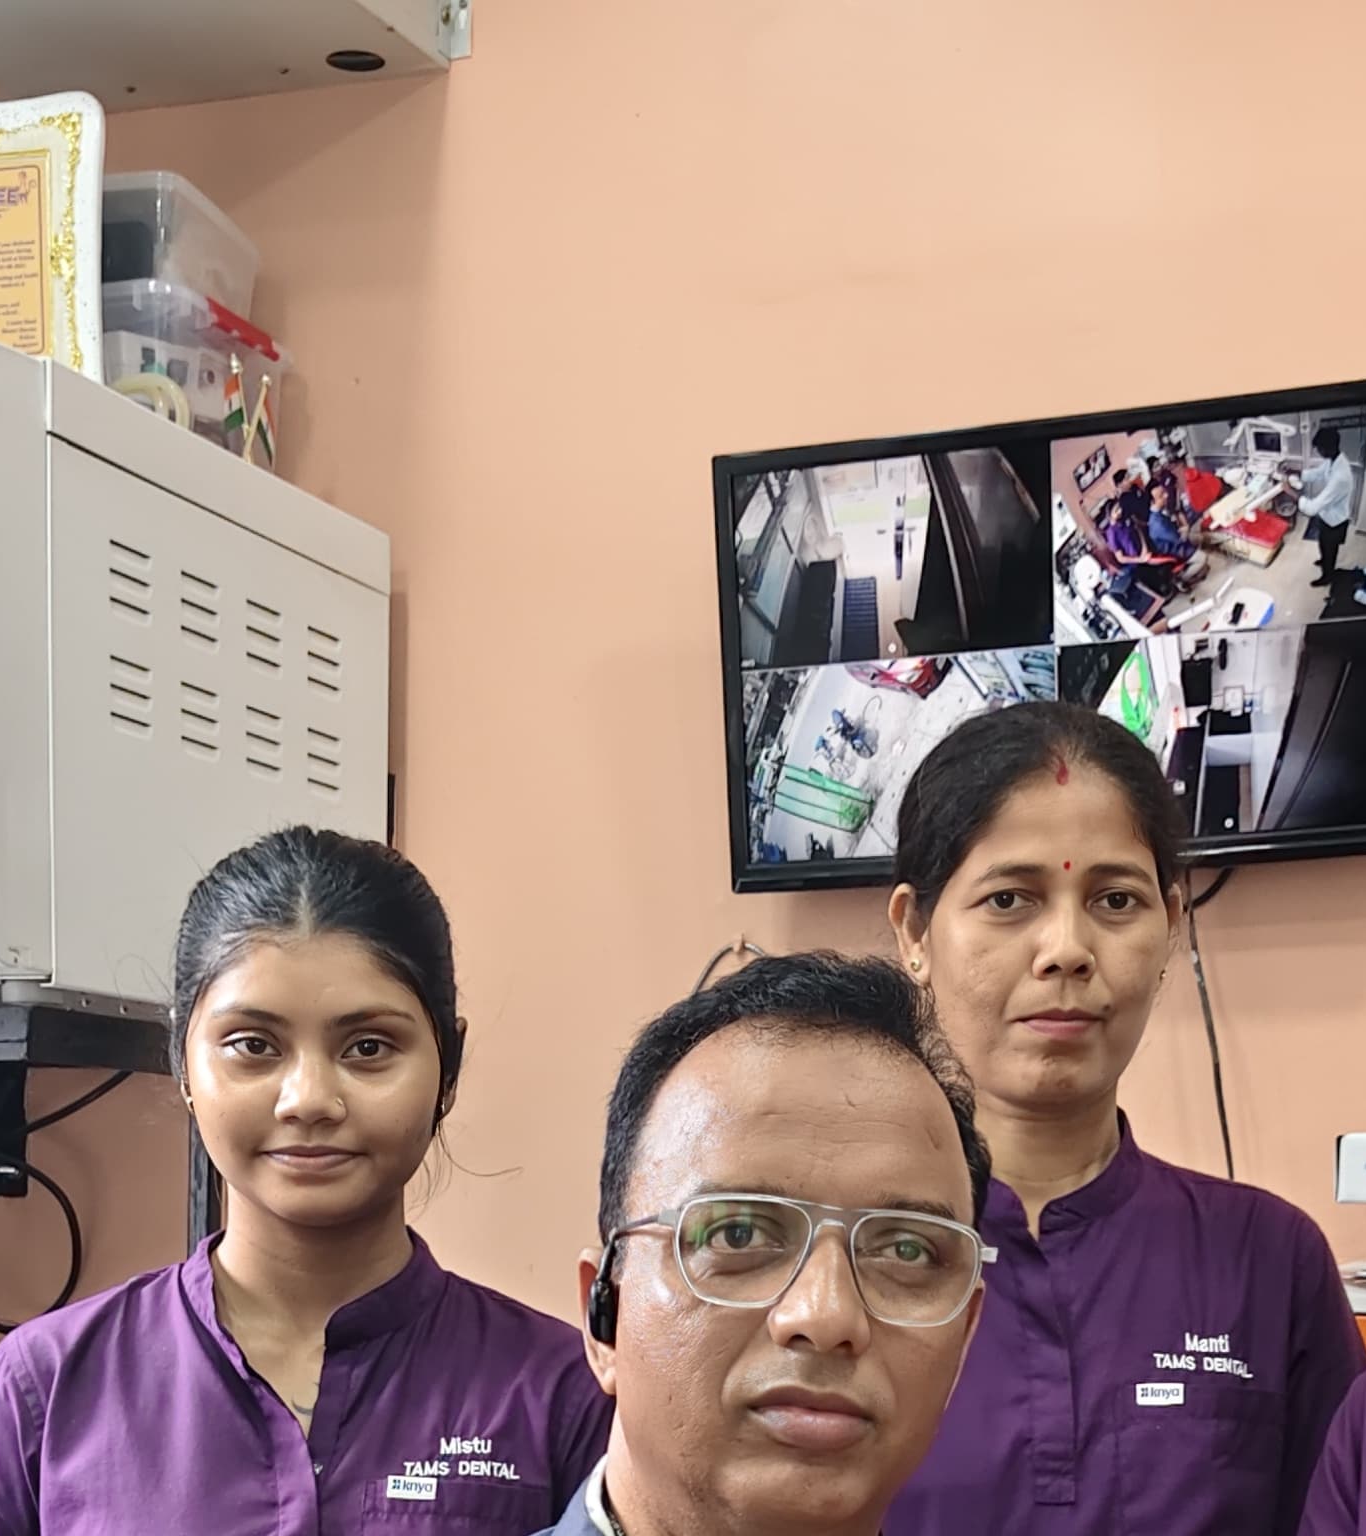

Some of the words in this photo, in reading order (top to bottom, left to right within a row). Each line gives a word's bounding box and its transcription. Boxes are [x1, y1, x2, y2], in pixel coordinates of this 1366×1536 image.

[1184, 1331, 1230, 1353] Manti
[1153, 1352, 1196, 1371] TAMS
[1202, 1356, 1254, 1379] DENTAL
[440, 1436, 493, 1455] Mistu
[403, 1460, 451, 1477] TAMS
[458, 1460, 521, 1480] DENTAL
[402, 1479, 433, 1494] knya
